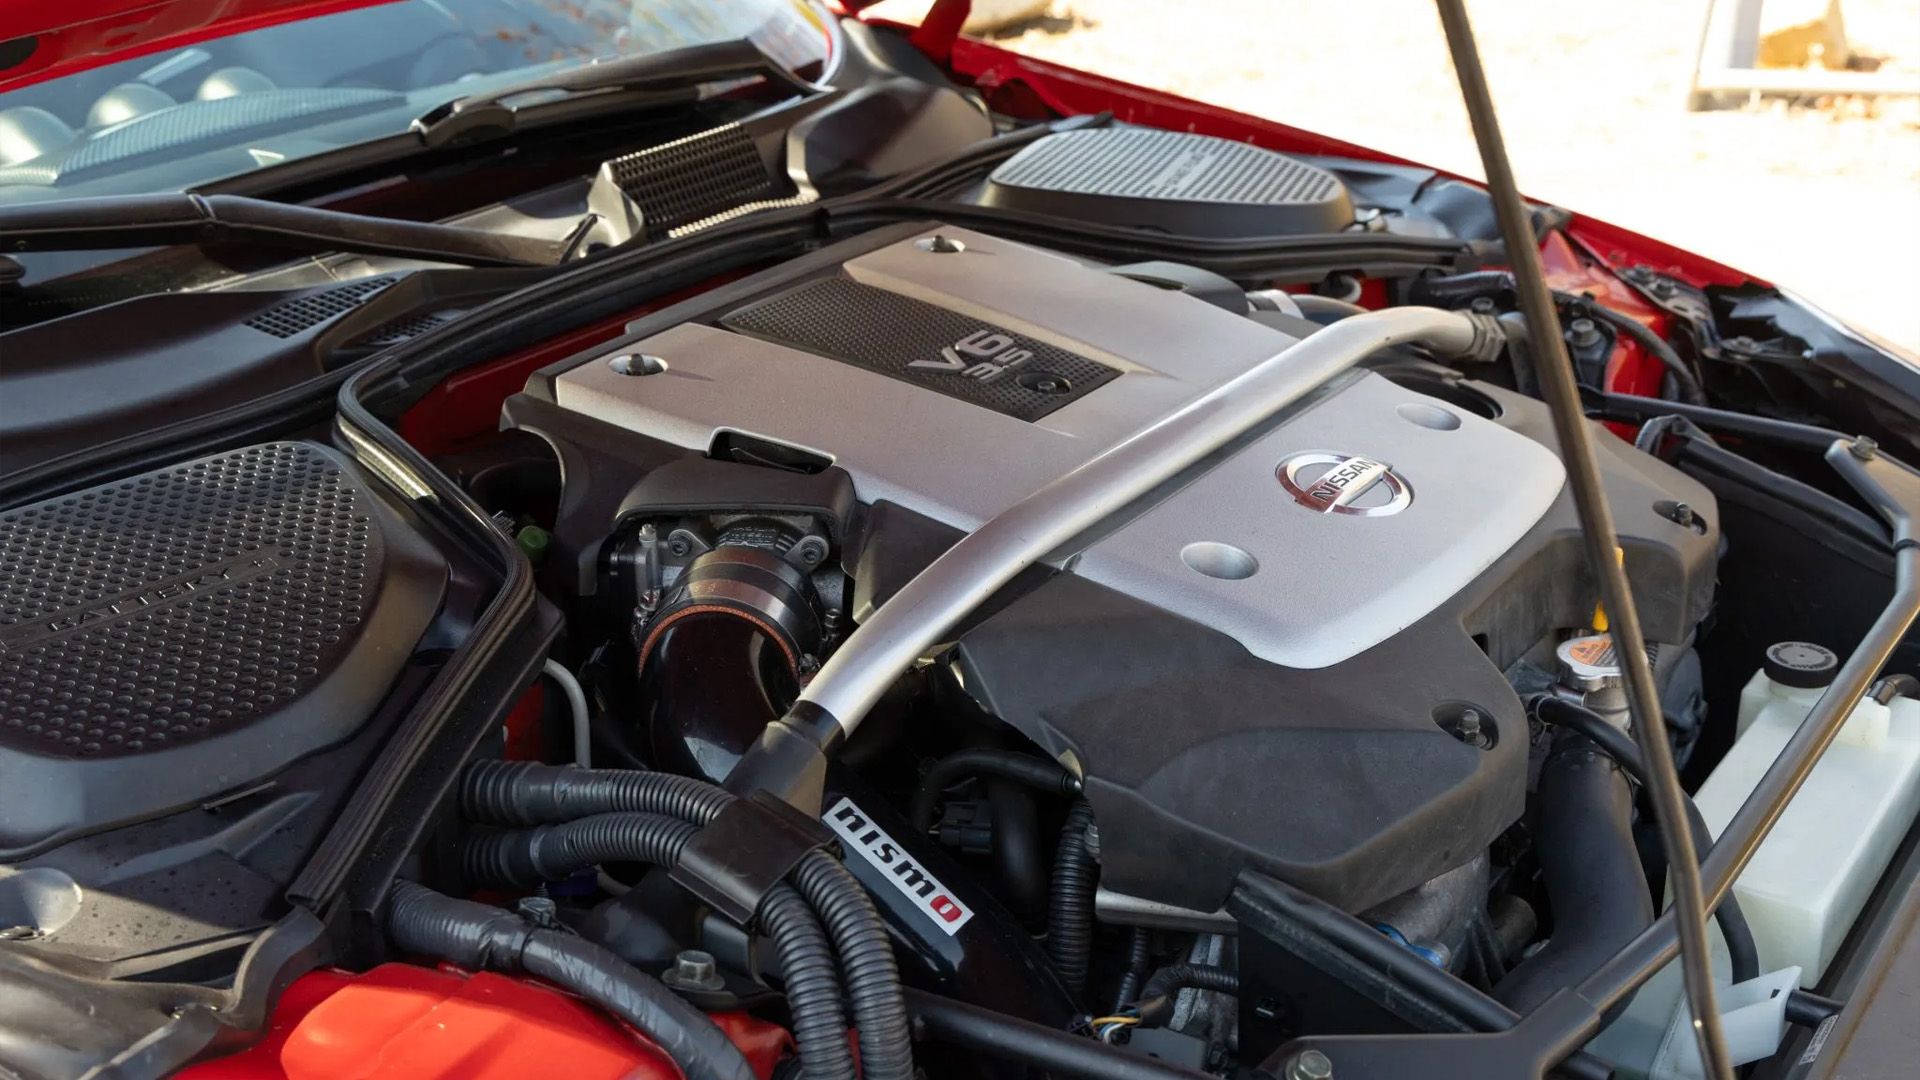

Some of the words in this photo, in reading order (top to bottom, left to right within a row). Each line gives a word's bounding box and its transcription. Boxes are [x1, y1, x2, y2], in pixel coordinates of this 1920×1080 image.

[907, 329, 1015, 372] V6
[1311, 459, 1379, 502] NISSAN
[834, 806, 963, 923] nismo
